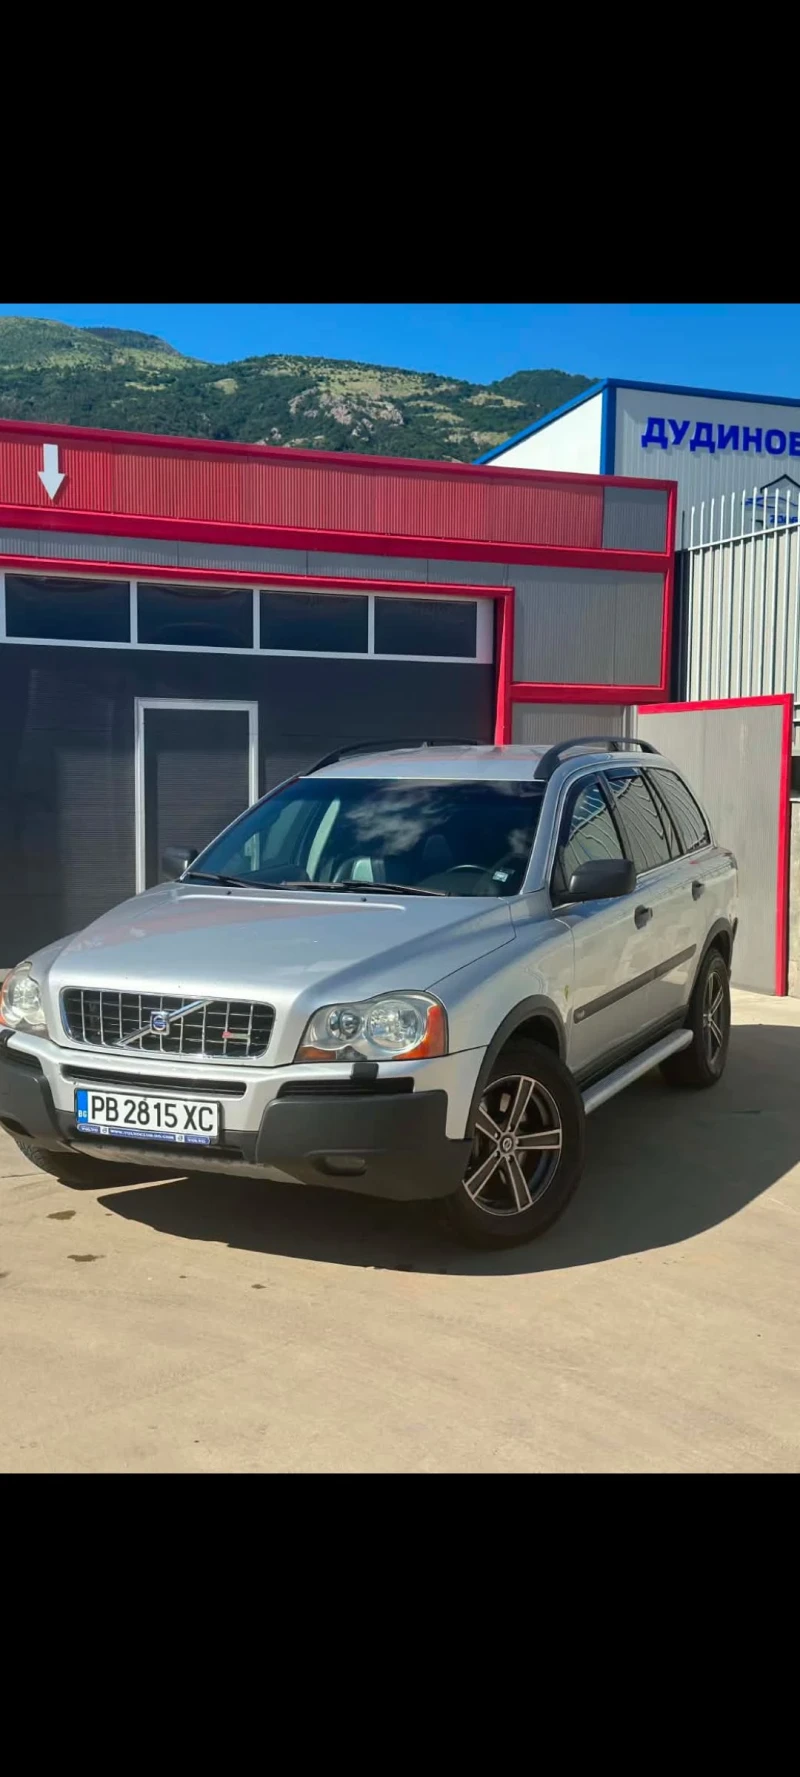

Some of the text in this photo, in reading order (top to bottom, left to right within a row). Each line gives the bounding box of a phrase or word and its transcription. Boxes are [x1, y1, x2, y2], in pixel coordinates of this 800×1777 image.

[78, 1110, 87, 1118] BG
[91, 1095, 214, 1132] PB 2815 XC
